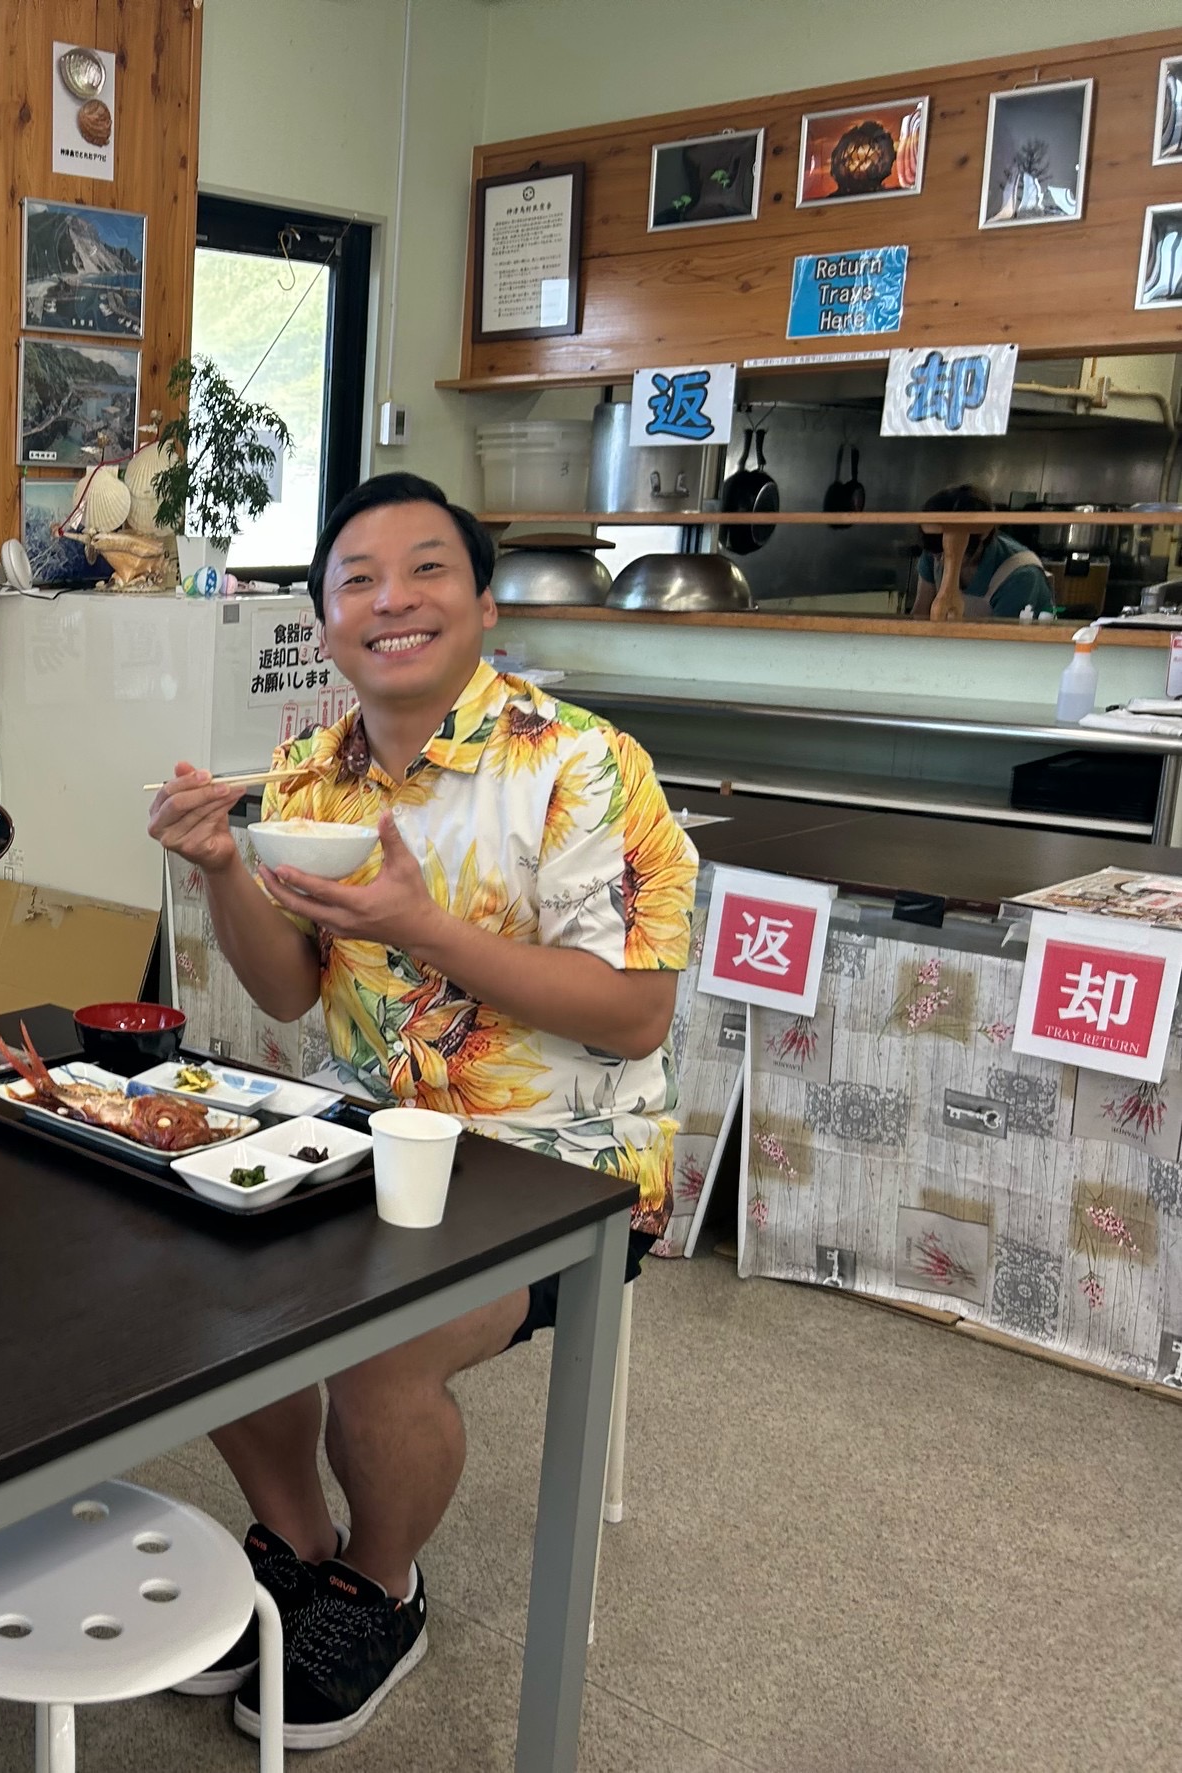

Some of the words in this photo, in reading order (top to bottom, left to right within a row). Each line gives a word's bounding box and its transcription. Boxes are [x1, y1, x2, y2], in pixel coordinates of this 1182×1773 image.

[815, 256, 882, 280] Return
[819, 283, 874, 306] Trays
[819, 309, 866, 332] Here
[645, 369, 715, 441] 返
[906, 349, 992, 431] 却
[274, 623, 313, 644] 食器は
[251, 668, 331, 694] お願いします
[731, 911, 791, 976] 返
[1057, 960, 1139, 1032] 却
[1044, 1024, 1079, 1042] TRAY
[1081, 1030, 1141, 1054] RETURN
[329, 1574, 357, 1595] gravis
